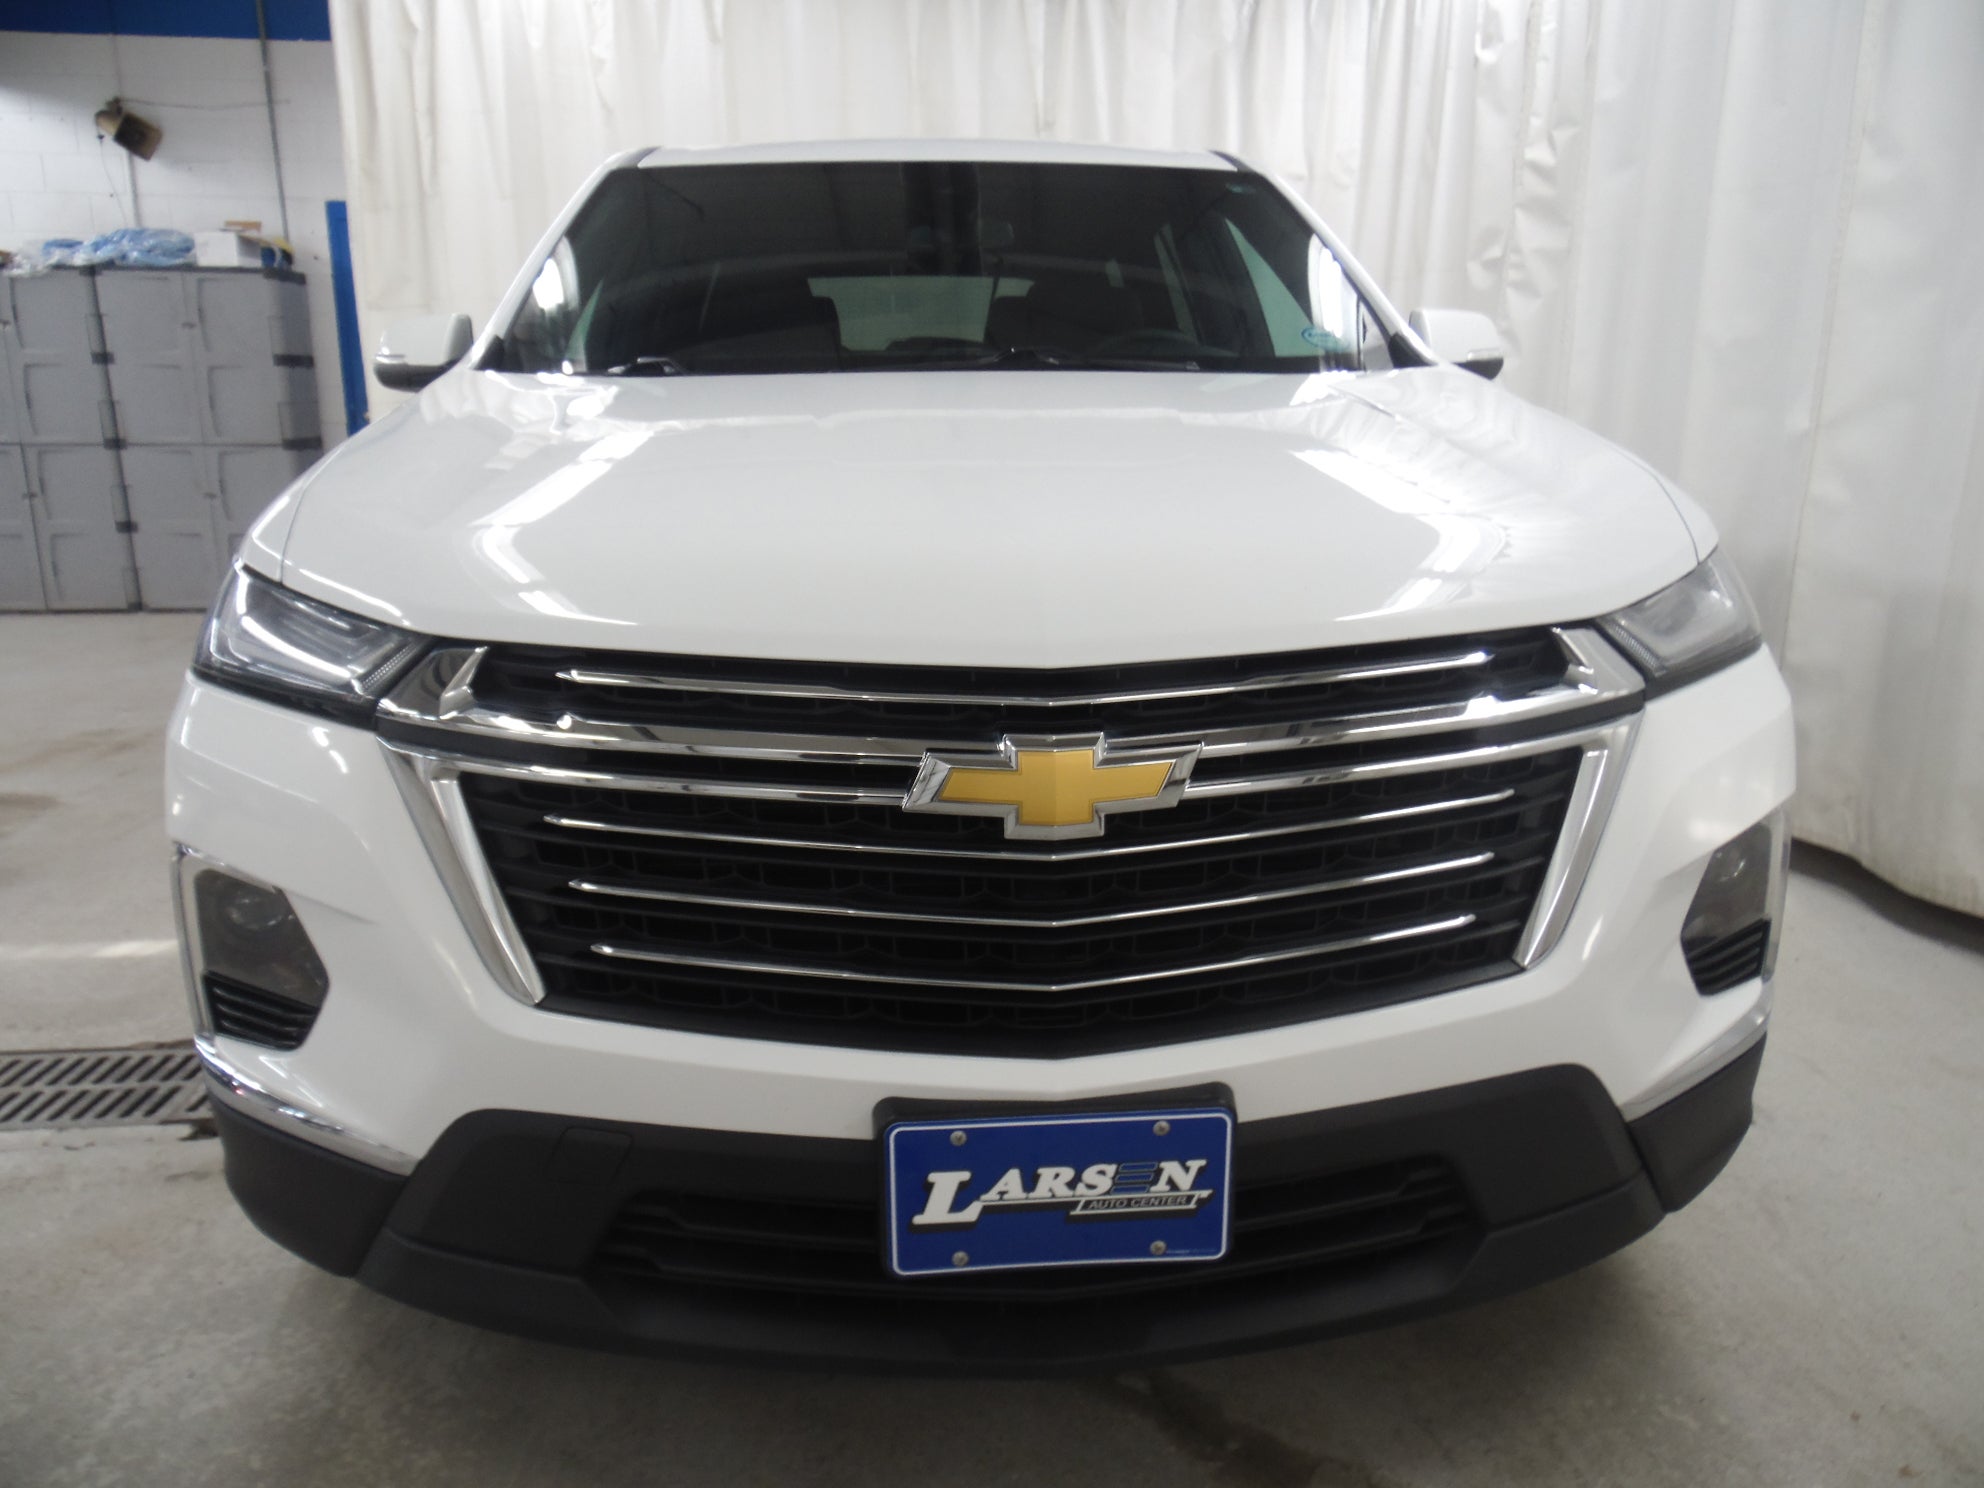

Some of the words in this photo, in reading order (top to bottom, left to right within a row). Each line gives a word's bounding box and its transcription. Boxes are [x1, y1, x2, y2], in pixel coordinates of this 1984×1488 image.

[912, 1159, 1207, 1225] LARSEN
[1090, 1197, 1128, 1210] AUTO
[1131, 1195, 1187, 1208] CENTER
